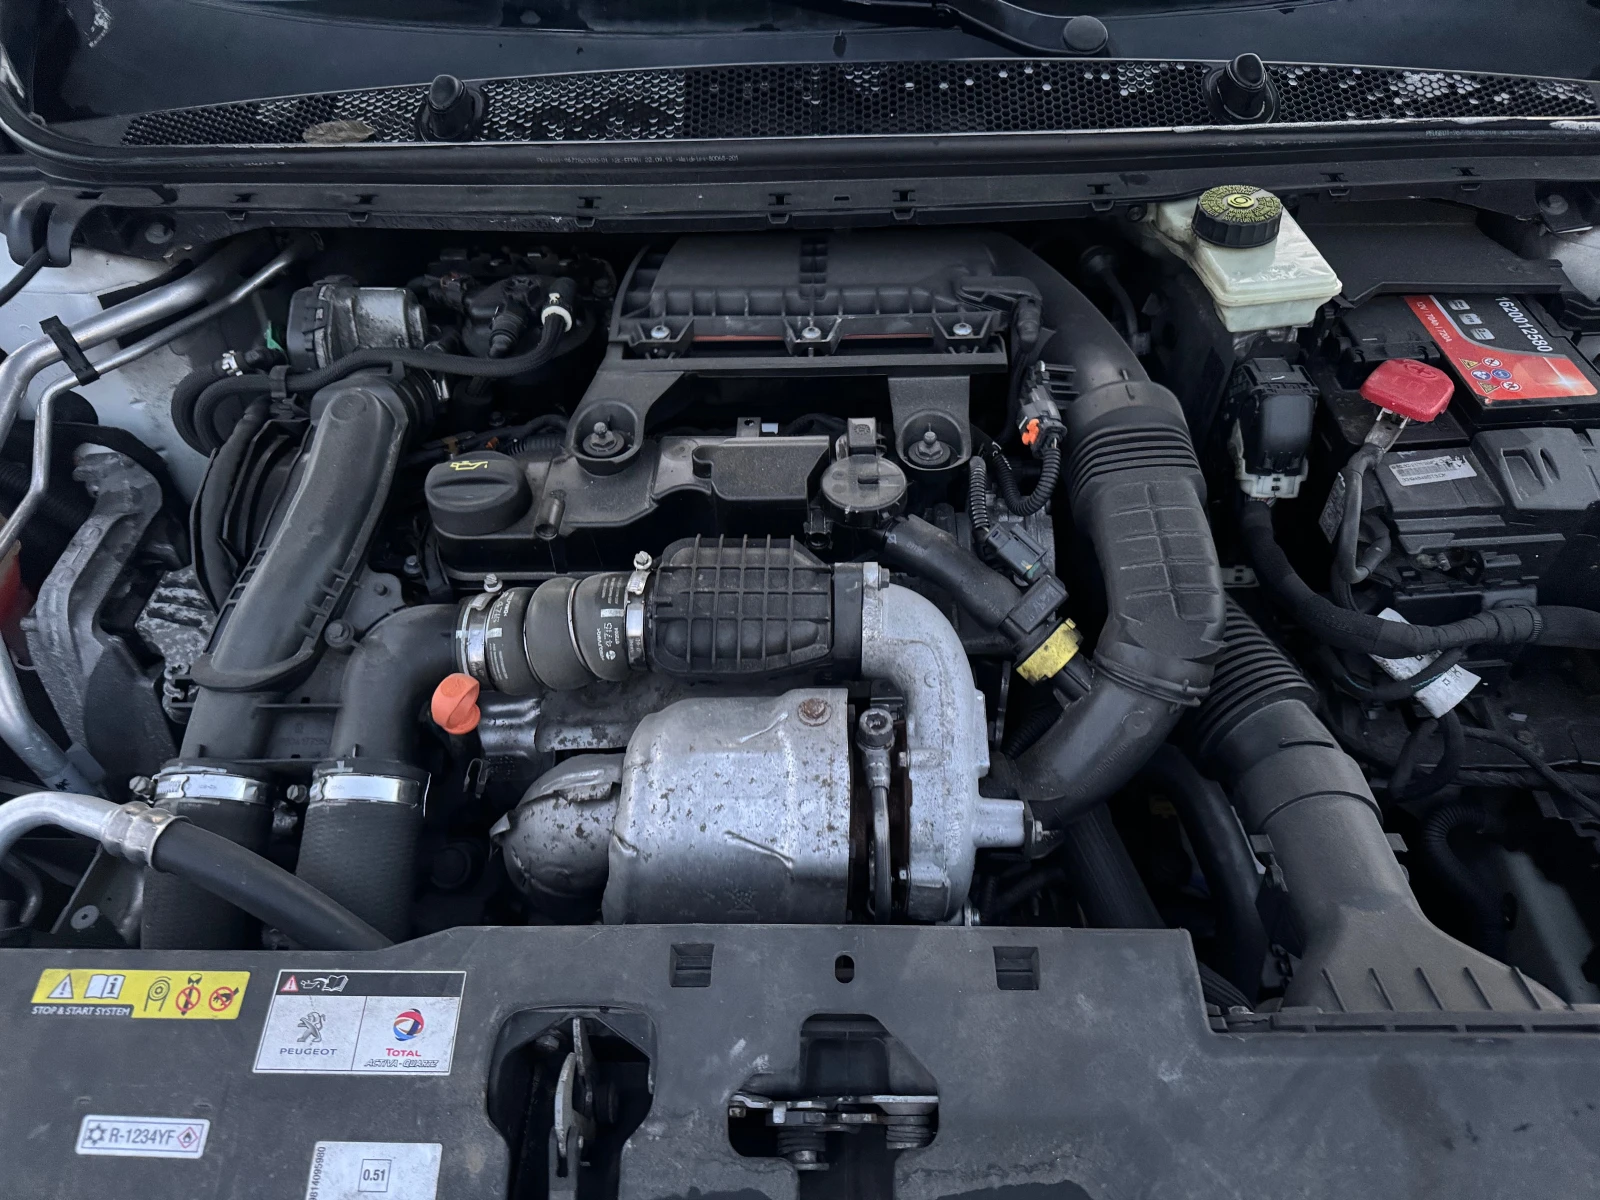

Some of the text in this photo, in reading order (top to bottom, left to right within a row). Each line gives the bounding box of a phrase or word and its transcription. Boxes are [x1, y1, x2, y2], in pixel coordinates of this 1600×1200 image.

[1495, 296, 1553, 352] 1620012580
[31, 1006, 131, 1016] STOP & START SYSTEM
[279, 1047, 338, 1056] PEUGEOT
[108, 1127, 176, 1146] R-1234YF
[362, 1168, 386, 1182] 0.51
